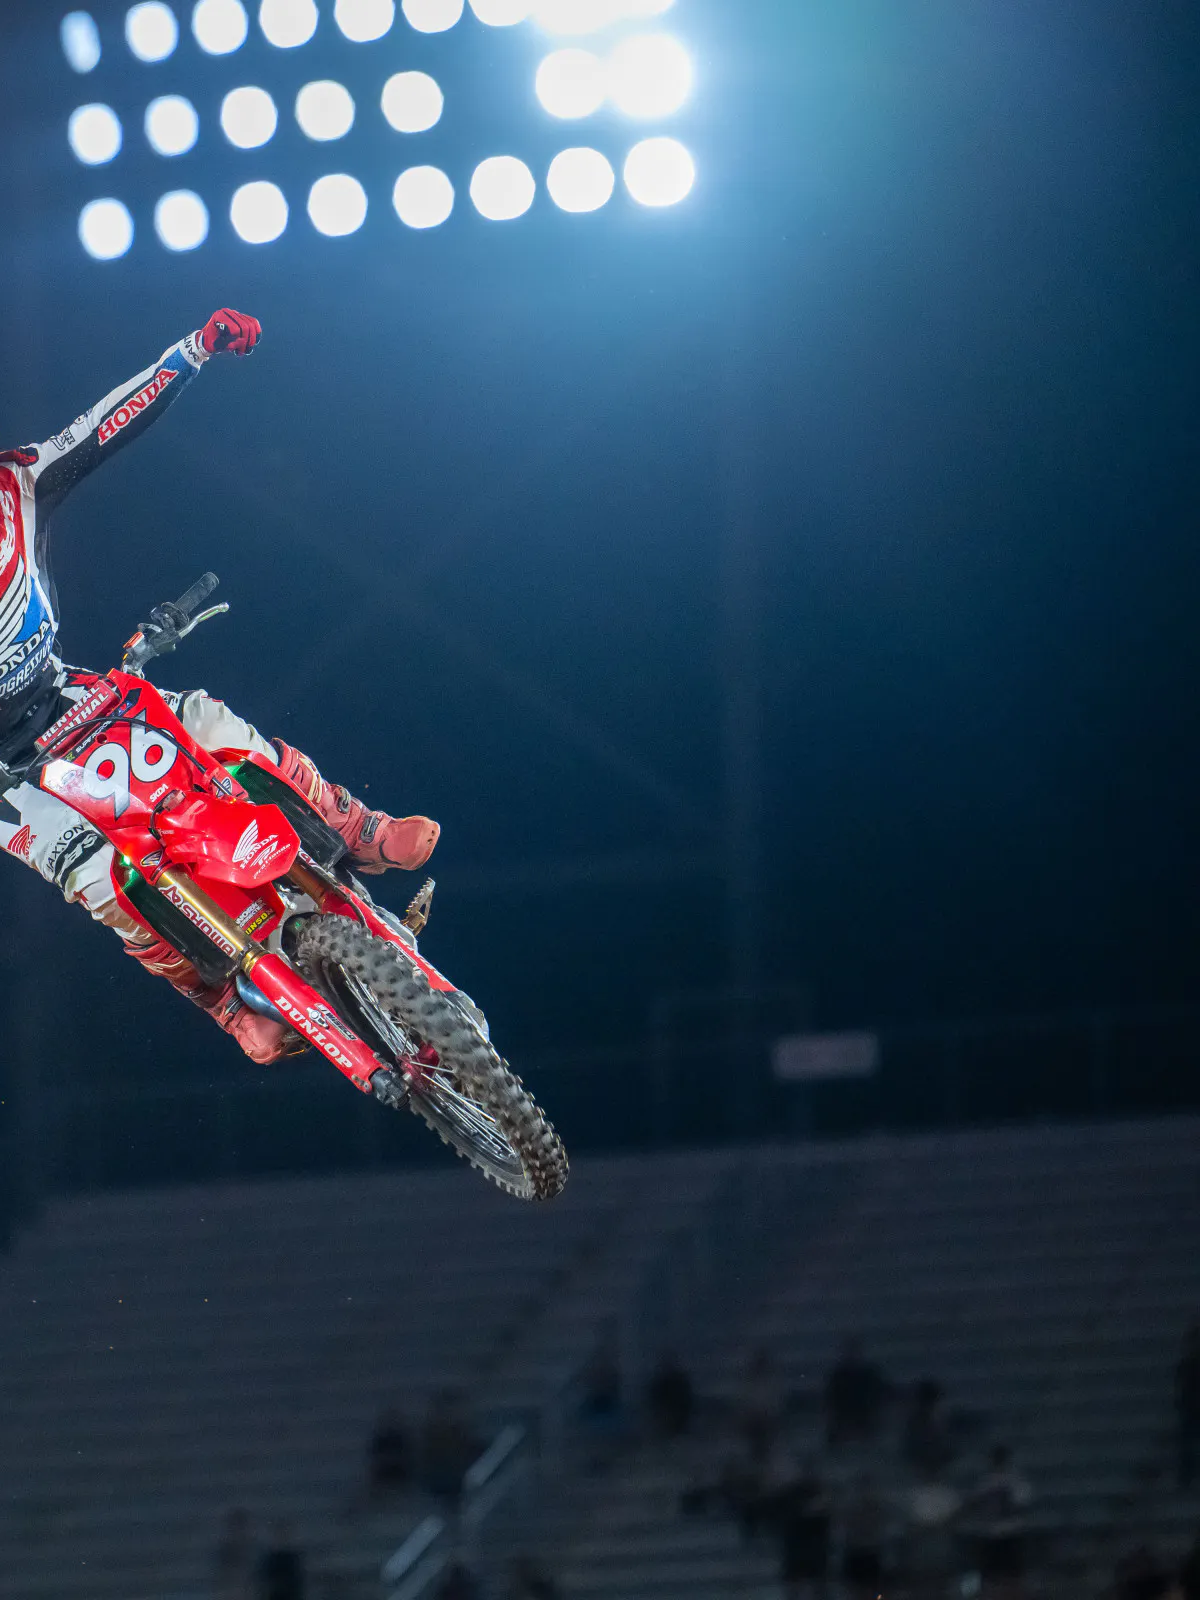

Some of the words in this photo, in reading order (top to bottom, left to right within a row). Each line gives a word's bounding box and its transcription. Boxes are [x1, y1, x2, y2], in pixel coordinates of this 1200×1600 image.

[97, 368, 179, 446] HONDA
[42, 682, 101, 742] RENTHAL
[74, 719, 113, 754] SUPERCRO
[83, 708, 178, 822] 96
[239, 834, 279, 869] HONDA
[175, 902, 237, 957] SHOWA
[275, 996, 353, 1070] DUNLOP
